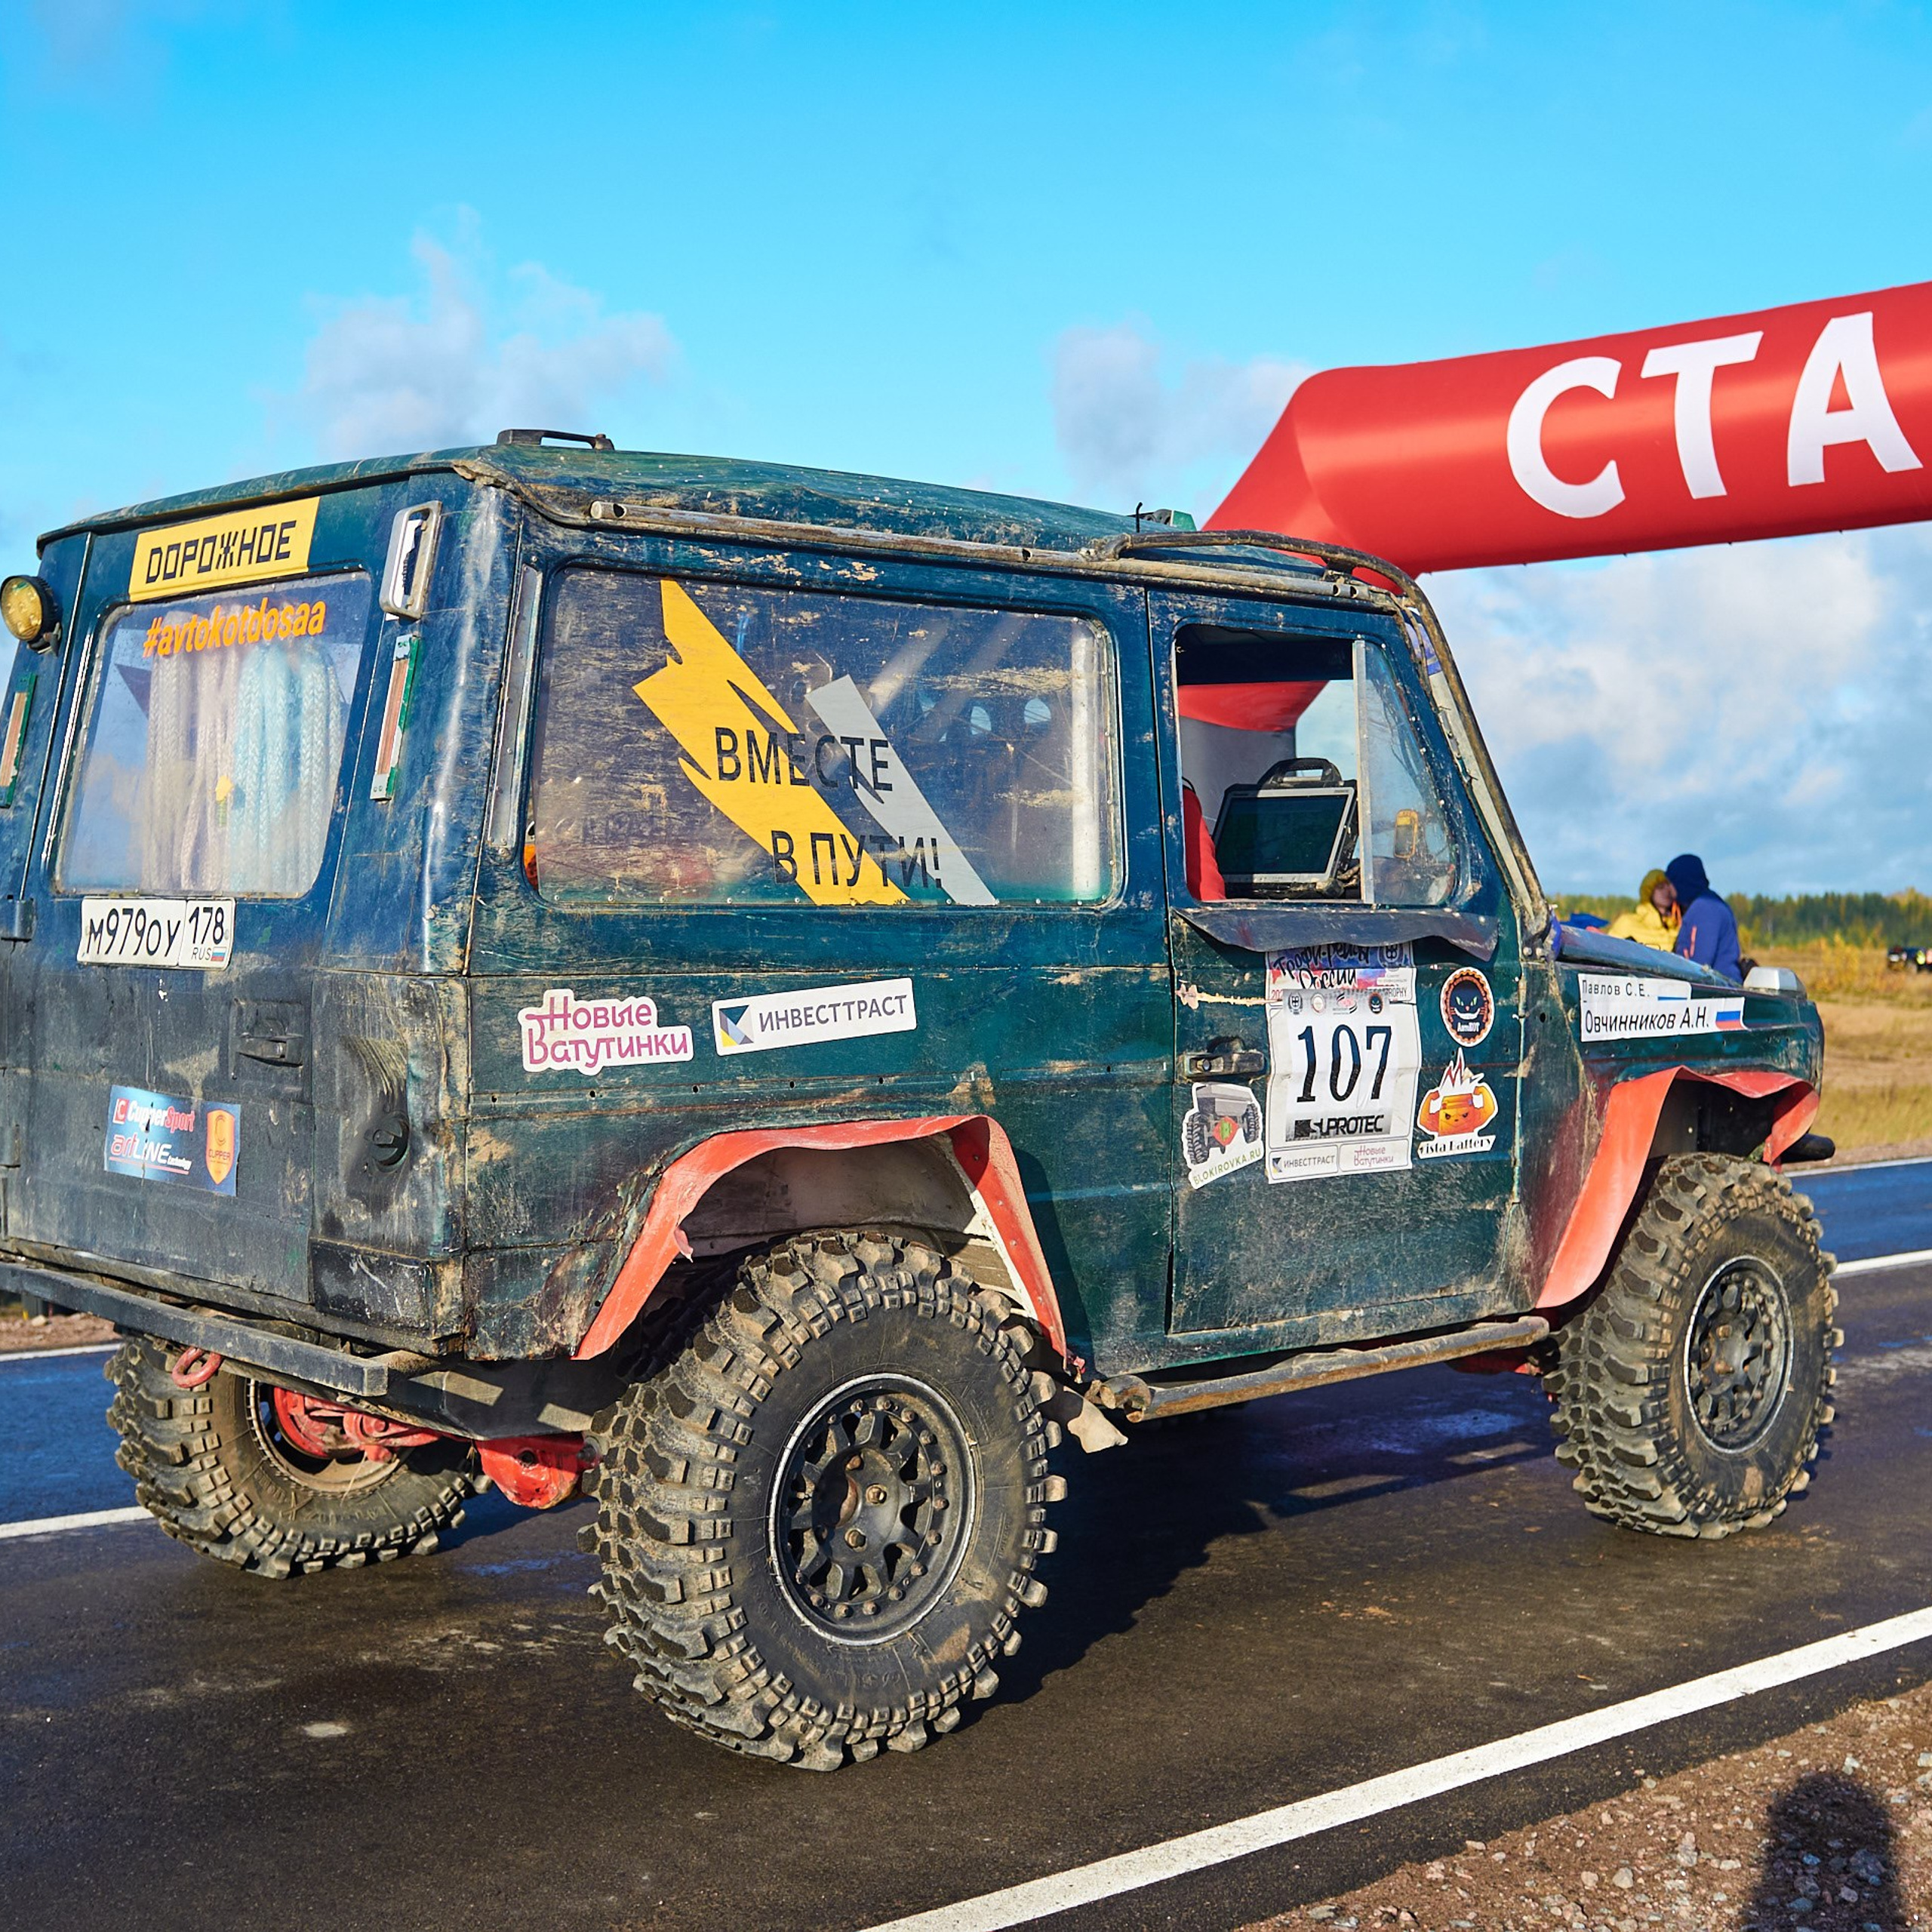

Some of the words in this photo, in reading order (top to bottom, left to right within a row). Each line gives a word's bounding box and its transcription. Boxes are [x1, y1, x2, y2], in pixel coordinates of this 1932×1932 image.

[1507, 311, 1923, 518] СТА
[143, 597, 326, 658] #avtokotdosaa
[715, 728, 893, 791] ВМЕСТЕ
[771, 830, 798, 884] В
[810, 832, 942, 889] ПУТИ!
[189, 906, 224, 945] 178
[191, 946, 212, 960] RUS
[1582, 980, 1620, 995] Павлов
[525, 996, 652, 1031] Новые
[759, 995, 907, 1032] ИНВЕСТТРАСТ
[1586, 1010, 1676, 1033] Овчинников
[1680, 1006, 1709, 1029] А.Н.
[528, 1027, 688, 1069] Ватутинки
[1297, 1024, 1392, 1103] 107
[1193, 1148, 1262, 1185] BLOKIROVKA.RU
[1284, 1155, 1336, 1169] ИНВЕСТТРАСТ
